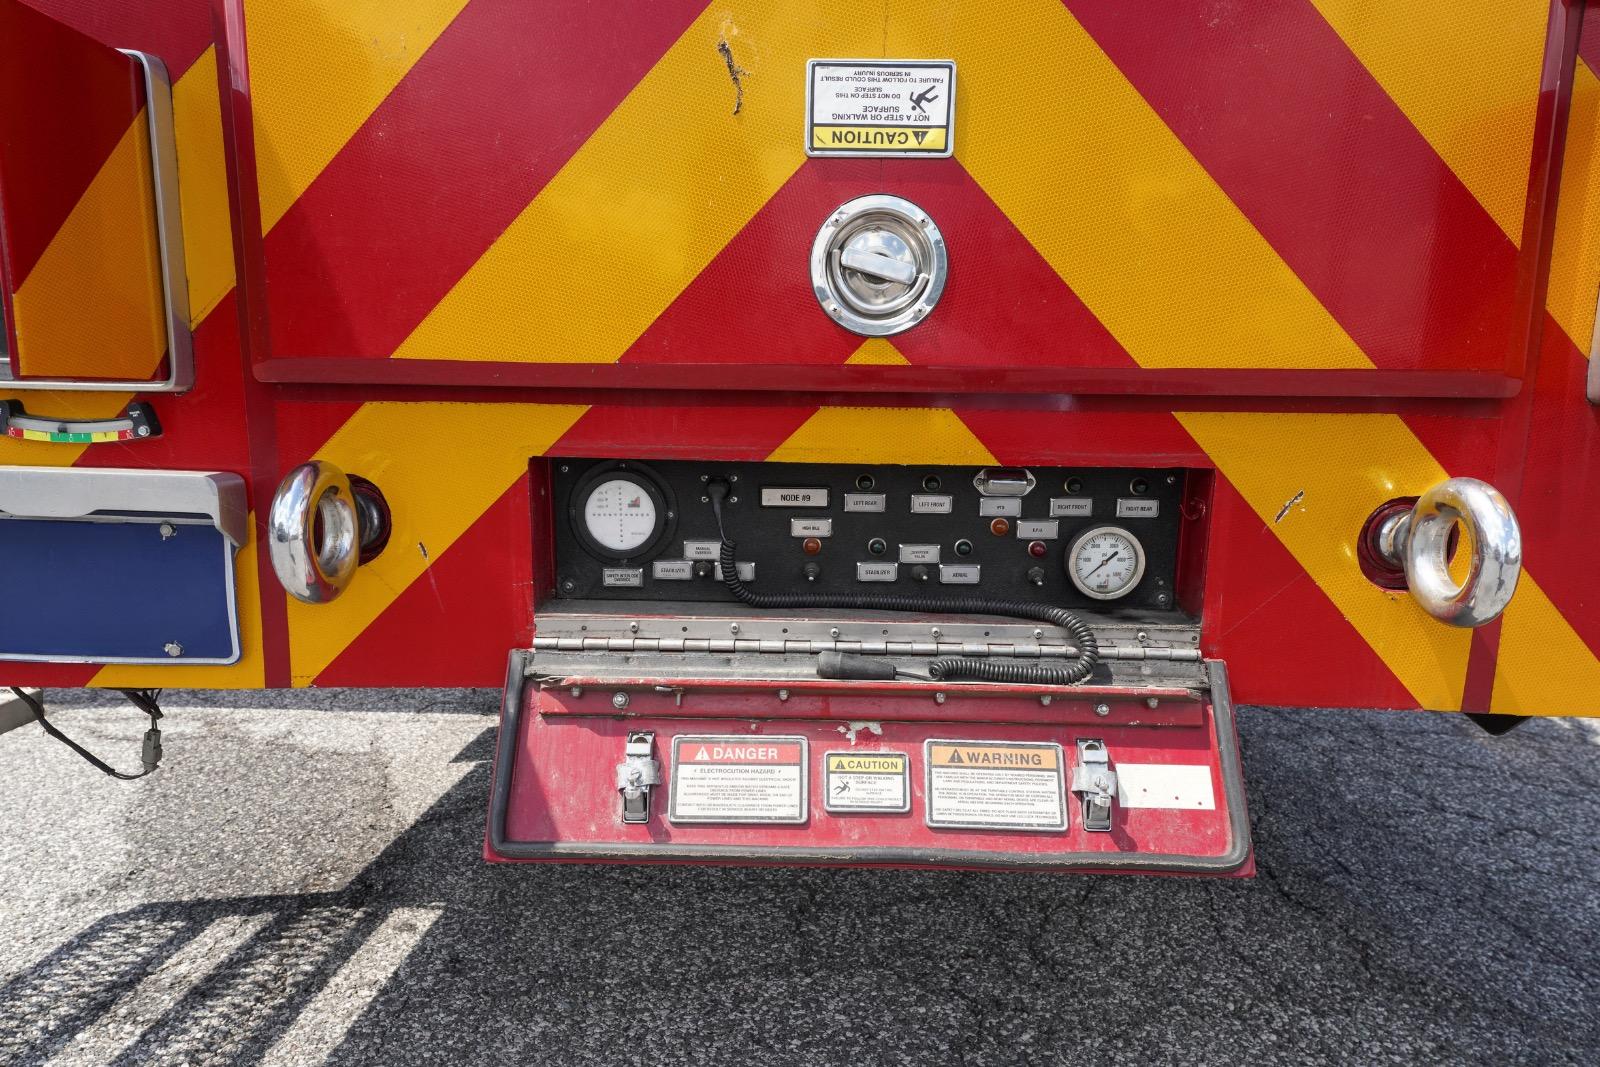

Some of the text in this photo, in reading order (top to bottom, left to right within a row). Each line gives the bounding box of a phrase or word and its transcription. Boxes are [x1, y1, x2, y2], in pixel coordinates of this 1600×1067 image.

[832, 131, 909, 144] CAUTION
[713, 747, 778, 760] DANGER
[967, 752, 1042, 765] WARNING
[848, 760, 898, 769] CAUTION
